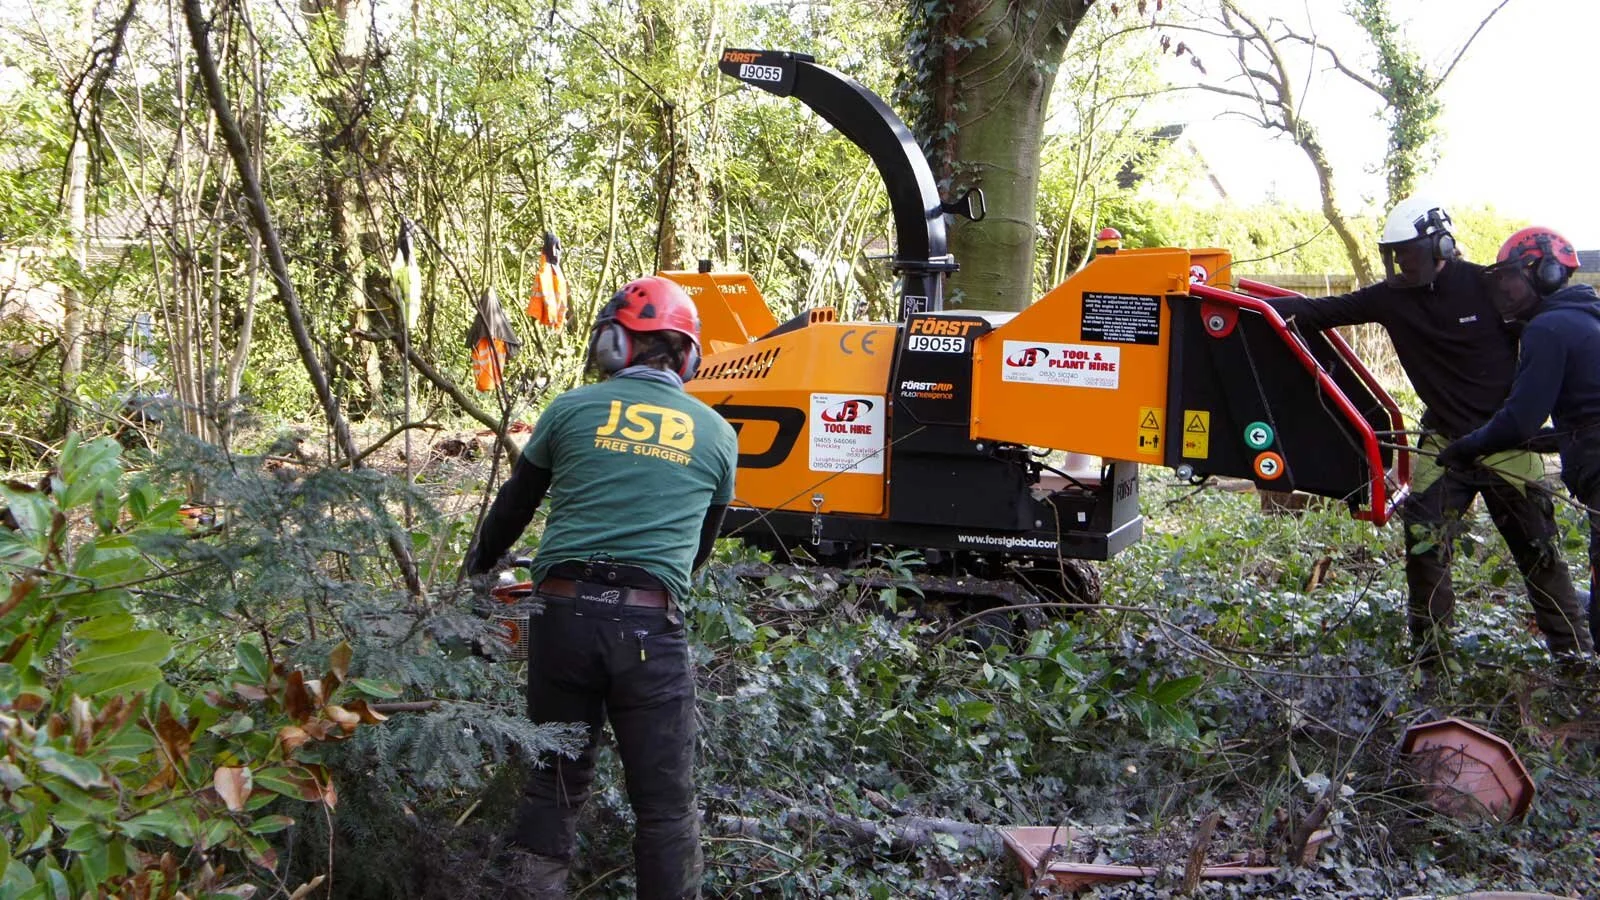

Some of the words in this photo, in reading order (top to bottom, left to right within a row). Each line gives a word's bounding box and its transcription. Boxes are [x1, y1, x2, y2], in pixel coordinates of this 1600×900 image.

[742, 66, 780, 80] J9055
[910, 317, 982, 336] FÖRST
[911, 337, 962, 352] J9055
[1062, 350, 1089, 360] TOOL
[1094, 352, 1102, 361] &
[1048, 360, 1085, 370] PLANT
[1088, 362, 1116, 372] HIRE
[596, 400, 694, 452] JSB
[824, 423, 848, 434] TOOL
[850, 424, 872, 434] HIRE
[594, 438, 628, 452] TREE
[633, 444, 692, 467] SURGERY
